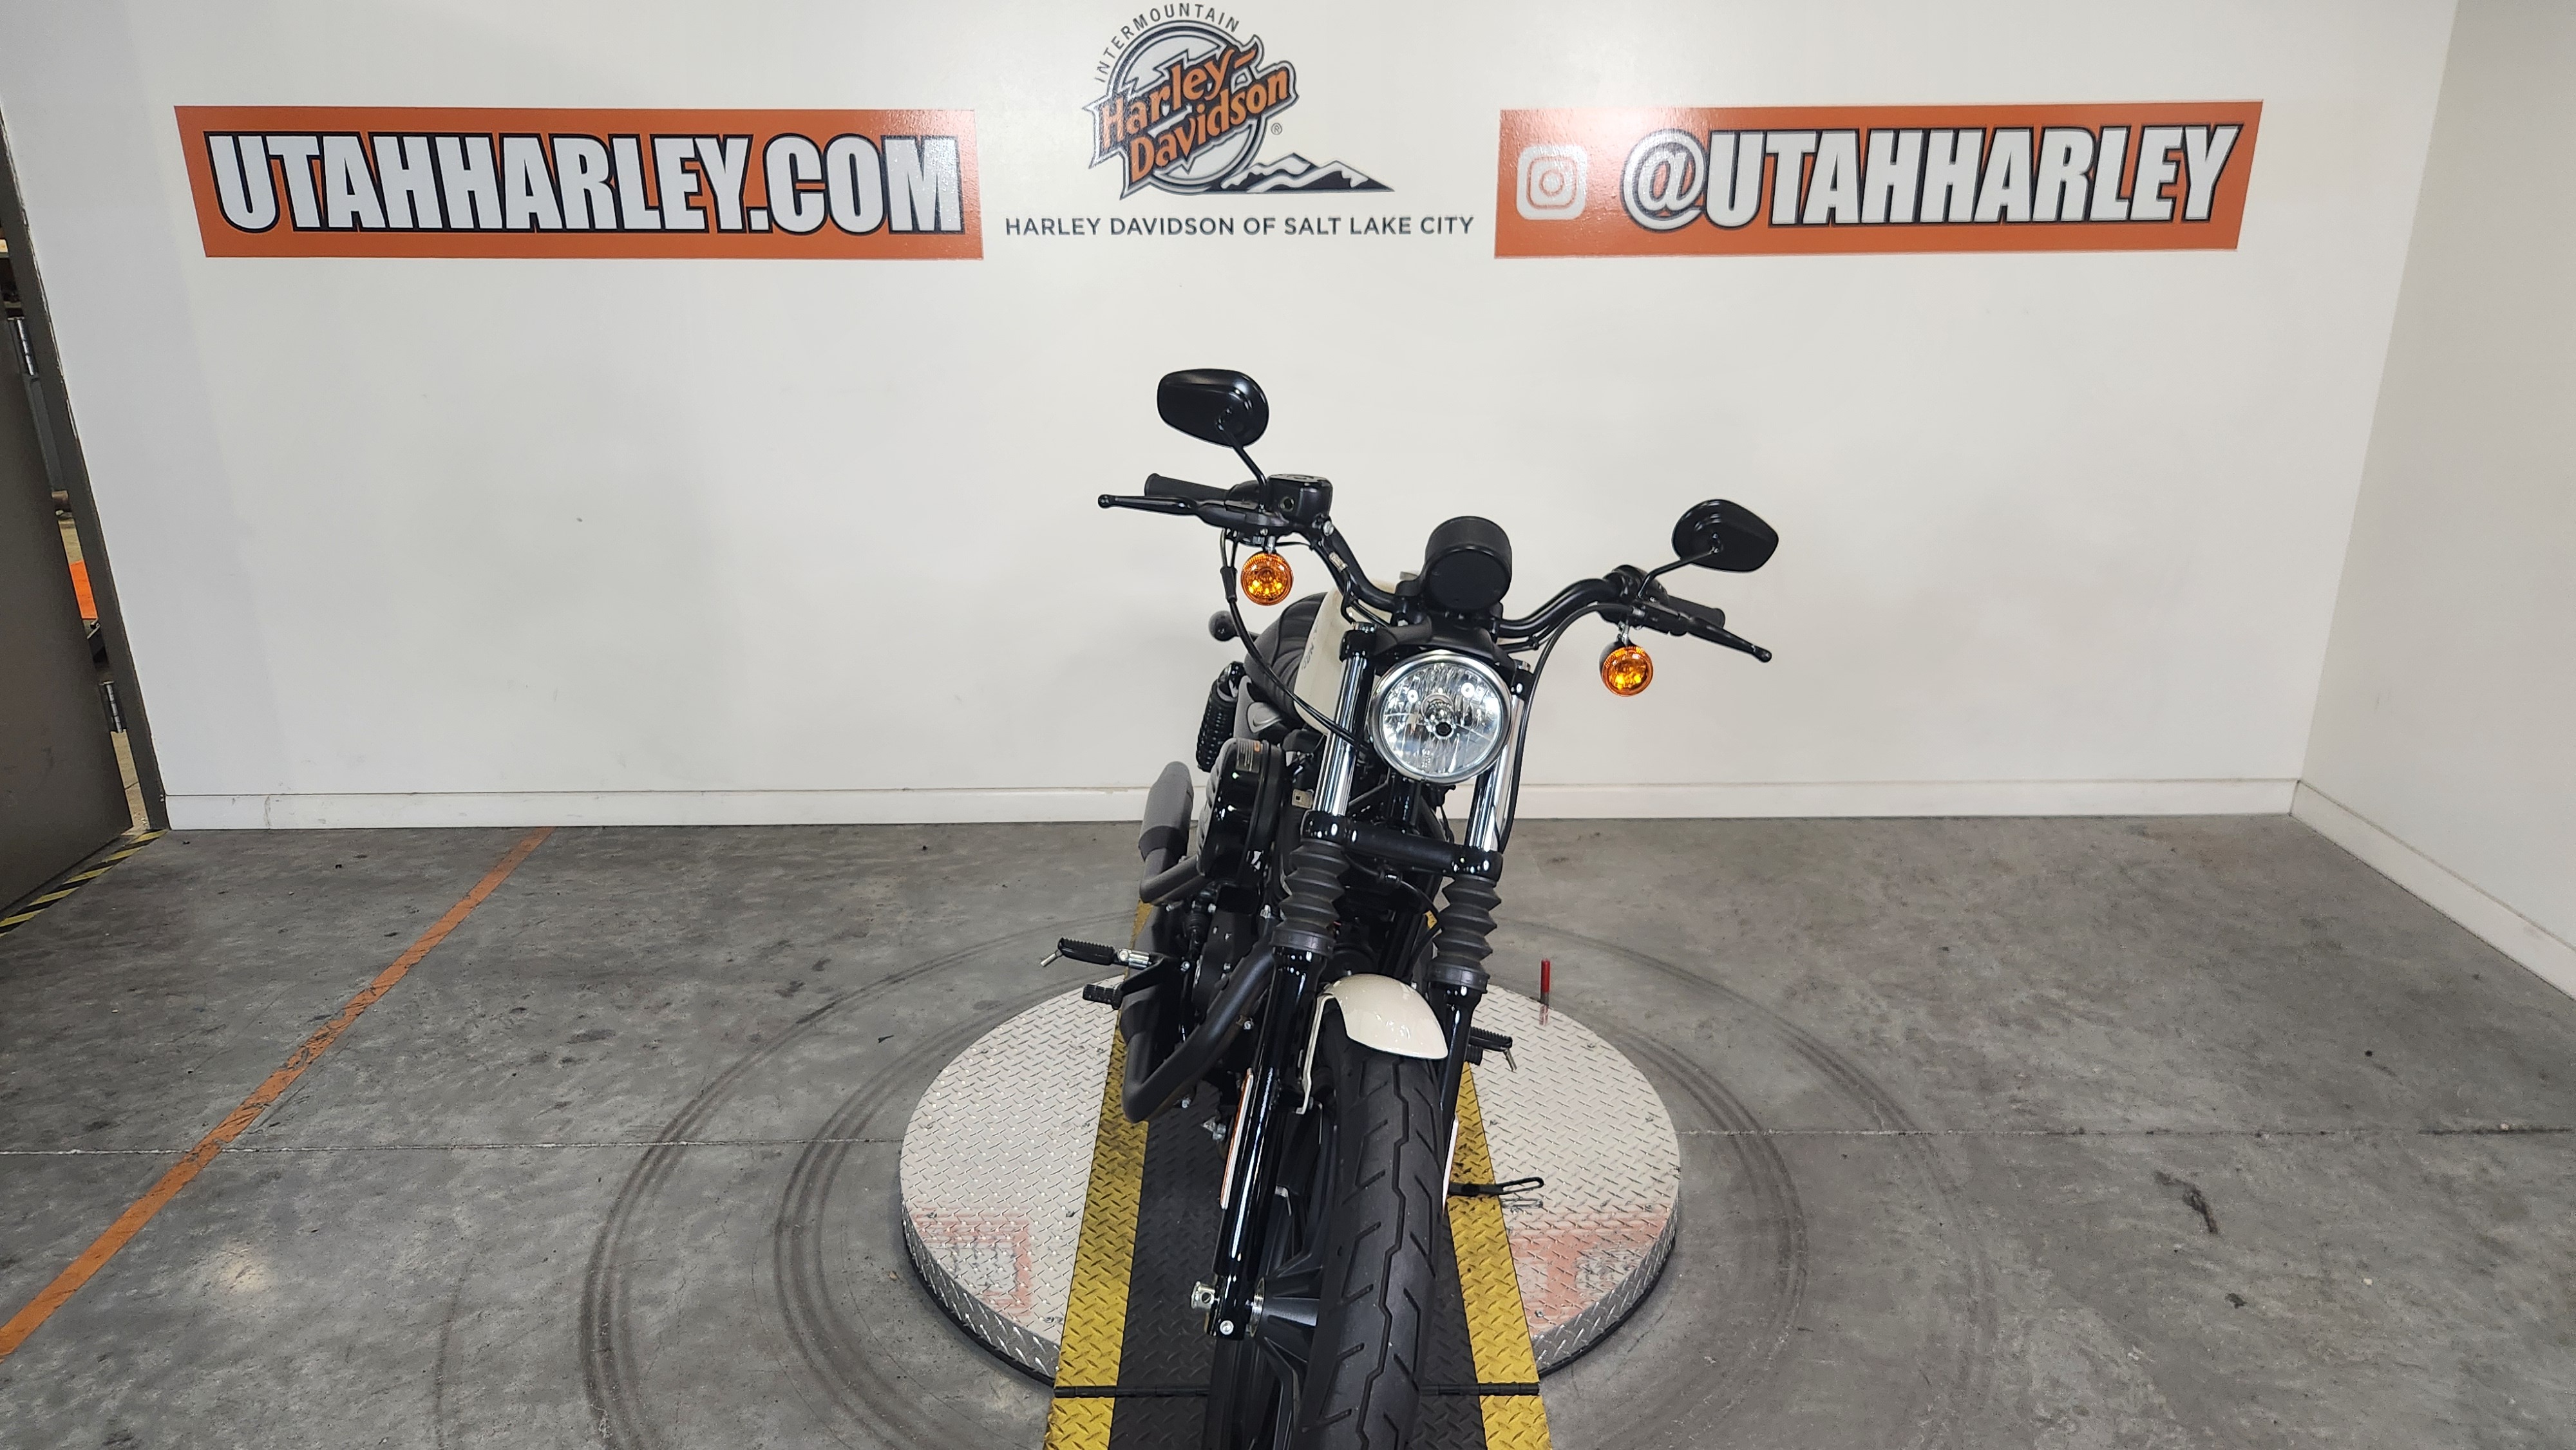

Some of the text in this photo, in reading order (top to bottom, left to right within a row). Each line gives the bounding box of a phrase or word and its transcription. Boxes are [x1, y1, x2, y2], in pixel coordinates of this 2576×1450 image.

[1094, 3, 1240, 83] INTERMOUNTAIN
[1129, 69, 1289, 184] Davidson
[1620, 122, 2244, 234] @UTAHHARLEY
[203, 130, 965, 236] UTAHHARLEY.COM
[1005, 216, 1475, 236] HARLEY DAVIDSON OF SALT LAKE CITY
